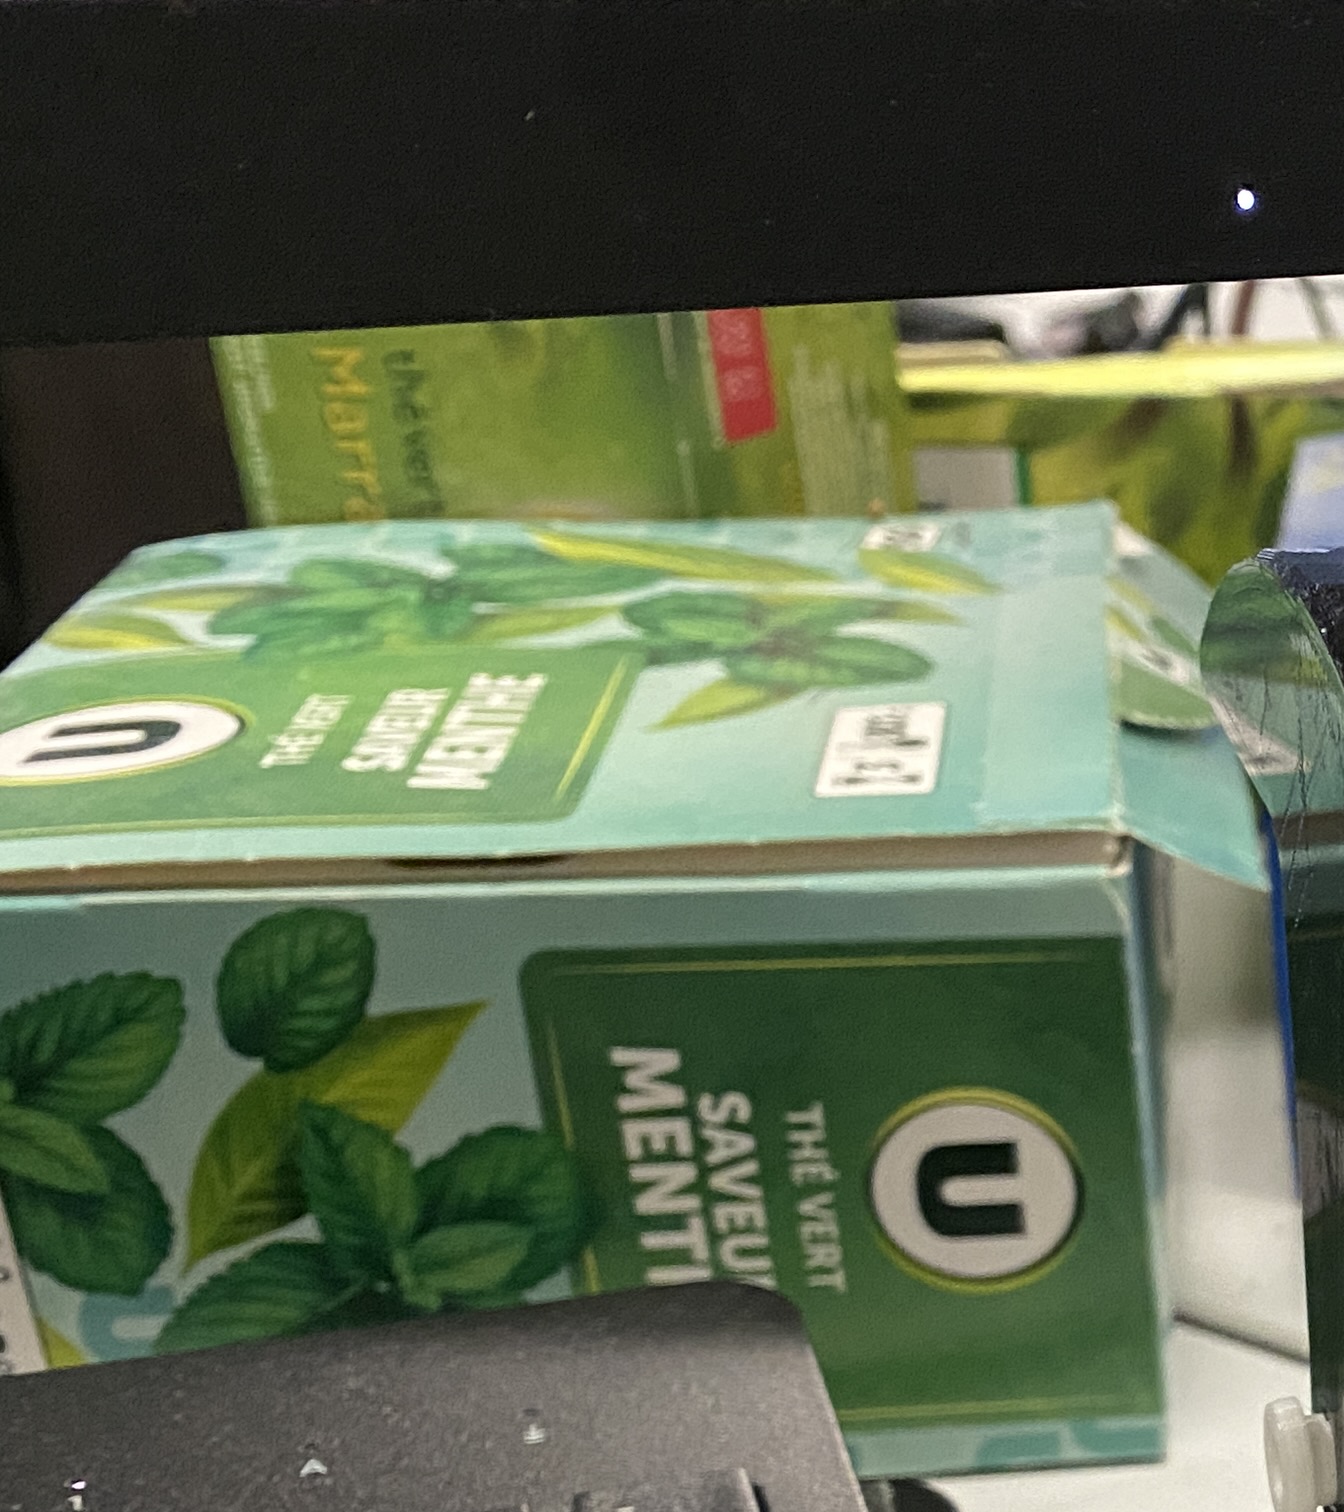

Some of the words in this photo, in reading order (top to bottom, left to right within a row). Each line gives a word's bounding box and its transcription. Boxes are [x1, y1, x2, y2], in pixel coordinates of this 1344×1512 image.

[20, 719, 184, 765] U
[340, 686, 451, 772] SAVEUR
[406, 672, 548, 790] MENTHE
[916, 1141, 1026, 1237] U
[796, 1191, 848, 1294] VERT
